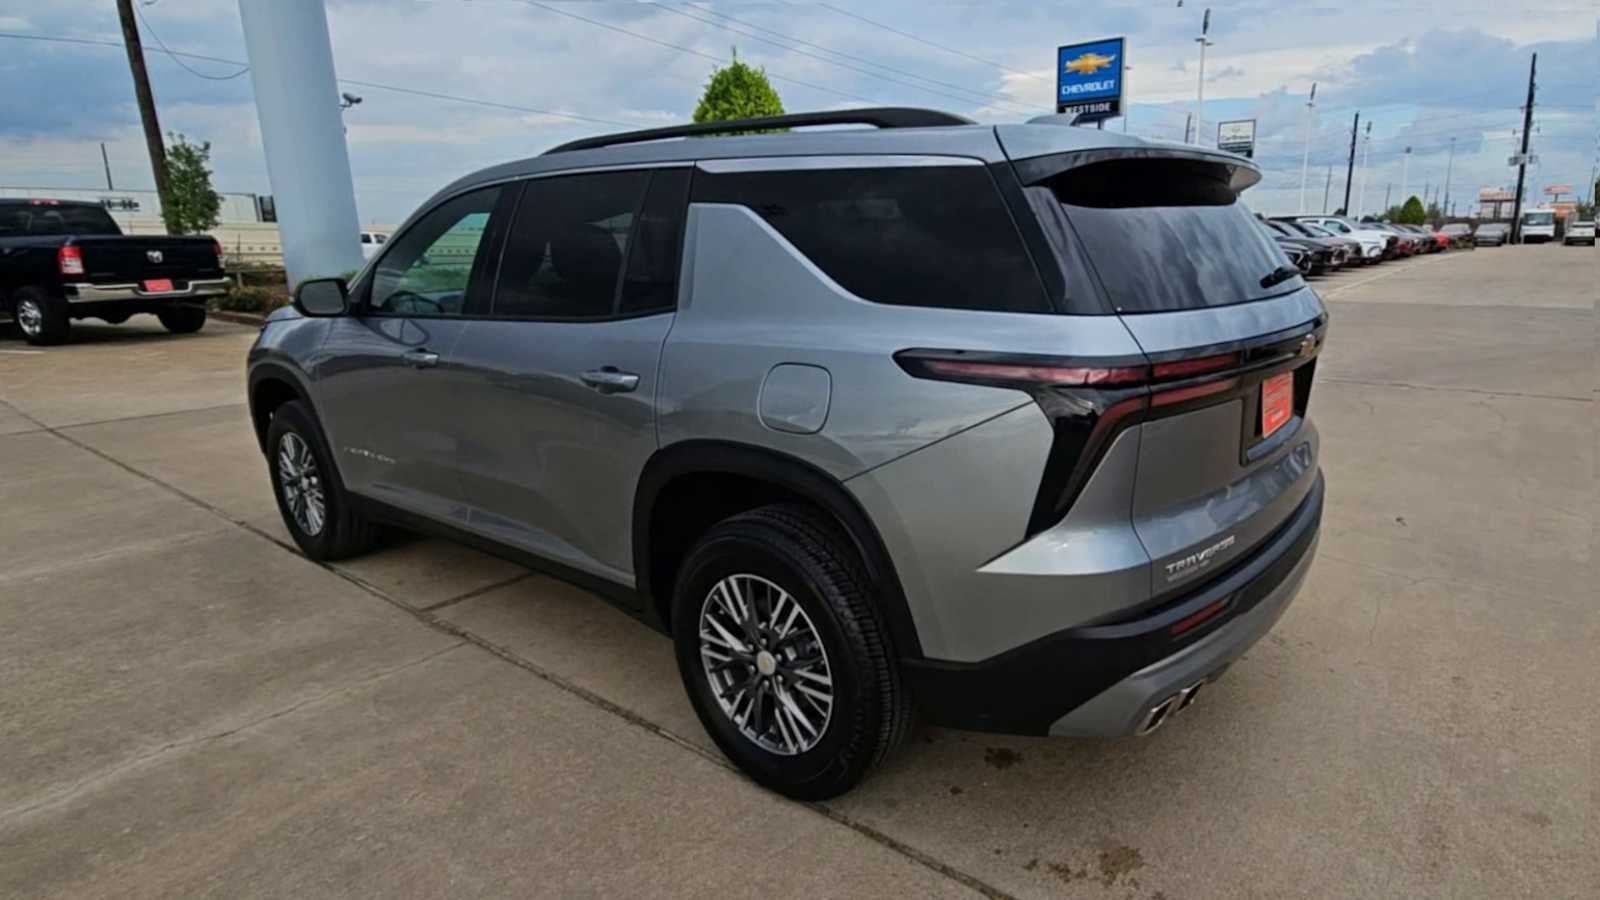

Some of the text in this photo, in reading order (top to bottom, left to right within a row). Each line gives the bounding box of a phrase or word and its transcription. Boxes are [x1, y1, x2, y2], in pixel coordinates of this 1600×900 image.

[1062, 80, 1116, 94] CHEVROLET
[1065, 102, 1111, 114] WESTSIDE
[1166, 535, 1235, 574] TRAVERSE
